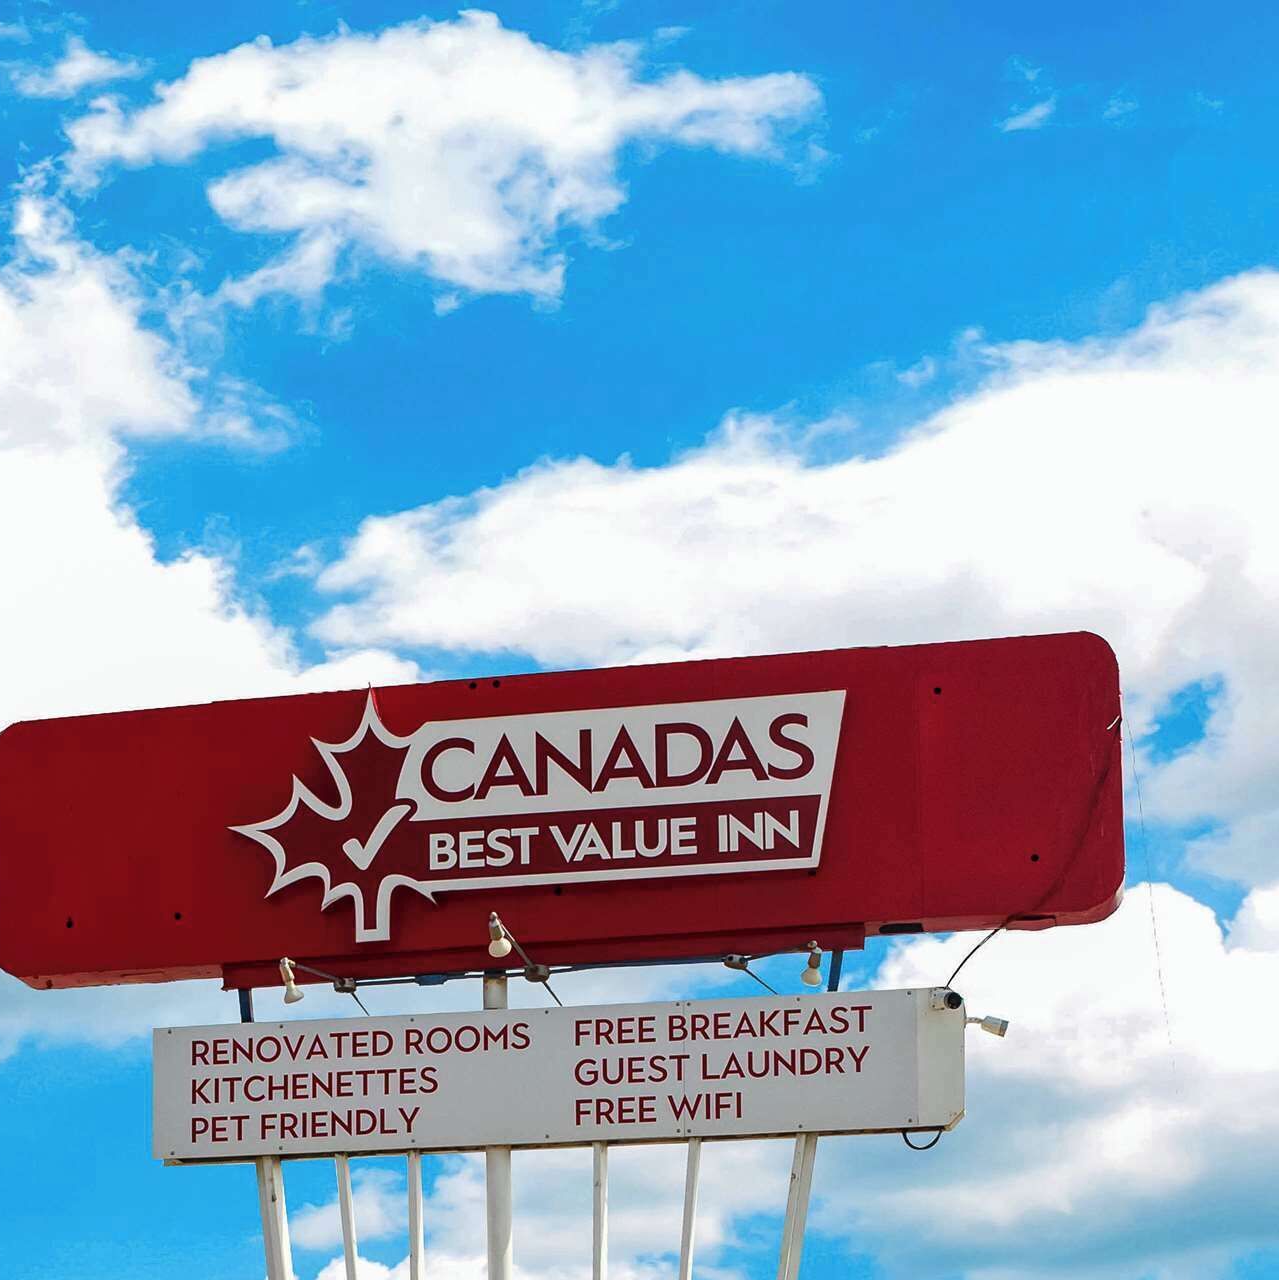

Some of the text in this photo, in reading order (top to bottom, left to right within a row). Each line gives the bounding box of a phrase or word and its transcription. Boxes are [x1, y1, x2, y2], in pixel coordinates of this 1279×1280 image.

[421, 715, 814, 804] CANADAS
[428, 810, 801, 871] BEST VALUE INN
[191, 1022, 532, 1066] RENOVATED ROOMS
[574, 1005, 874, 1046] FREE BREAKFAST
[191, 1066, 439, 1105] KITCHENETTES
[574, 1045, 870, 1086] GUEST LAUNDRY
[191, 1106, 421, 1144] PET FRIENDLY
[575, 1091, 743, 1126] FREE WIFI
